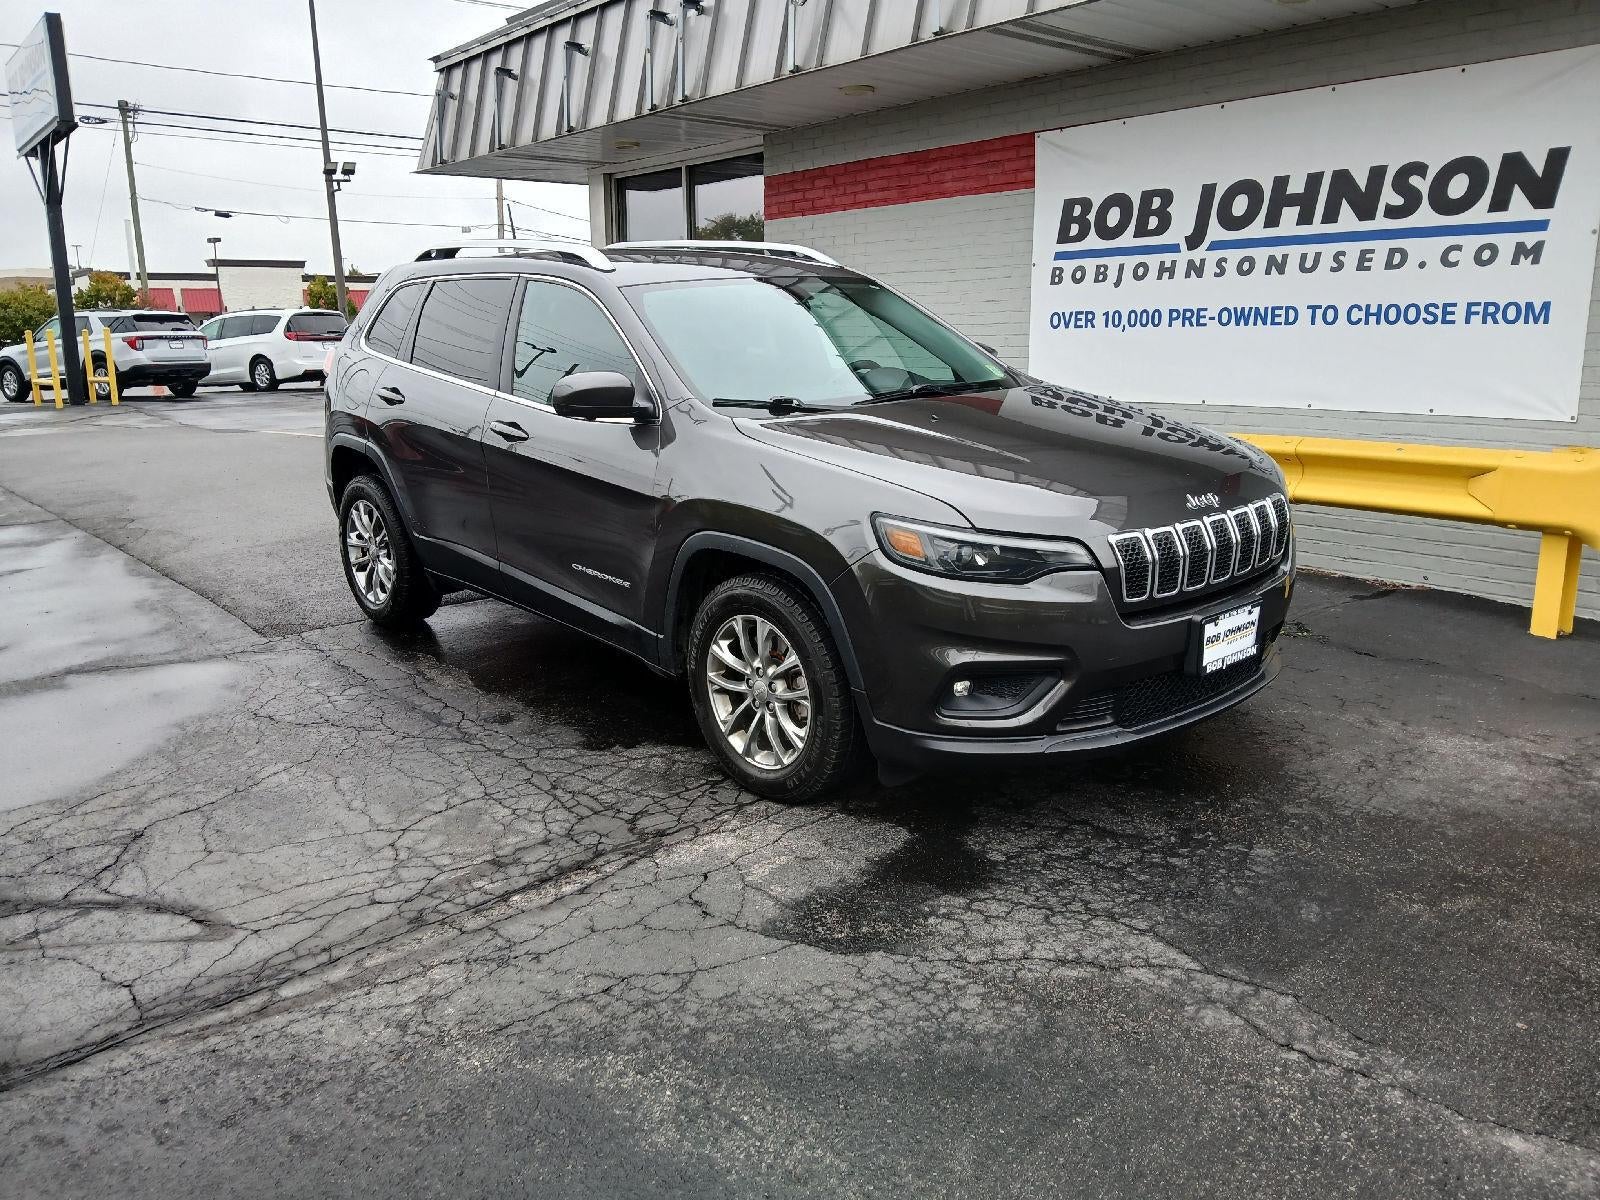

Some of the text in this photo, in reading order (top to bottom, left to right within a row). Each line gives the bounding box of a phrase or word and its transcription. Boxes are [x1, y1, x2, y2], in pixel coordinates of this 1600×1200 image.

[1055, 145, 1572, 252] BOB JOHNSON
[1049, 239, 1546, 289] BOBJOHNSONUSED.COM
[1049, 300, 1553, 332] OVER 10,000 PRE-OWNED TO CHOOSE FROM
[1185, 492, 1220, 510] Jeep
[571, 563, 631, 588] CHEROKEE
[1205, 618, 1257, 647] BOB JOHNSON
[1206, 644, 1259, 673] BOB JOHNSON
